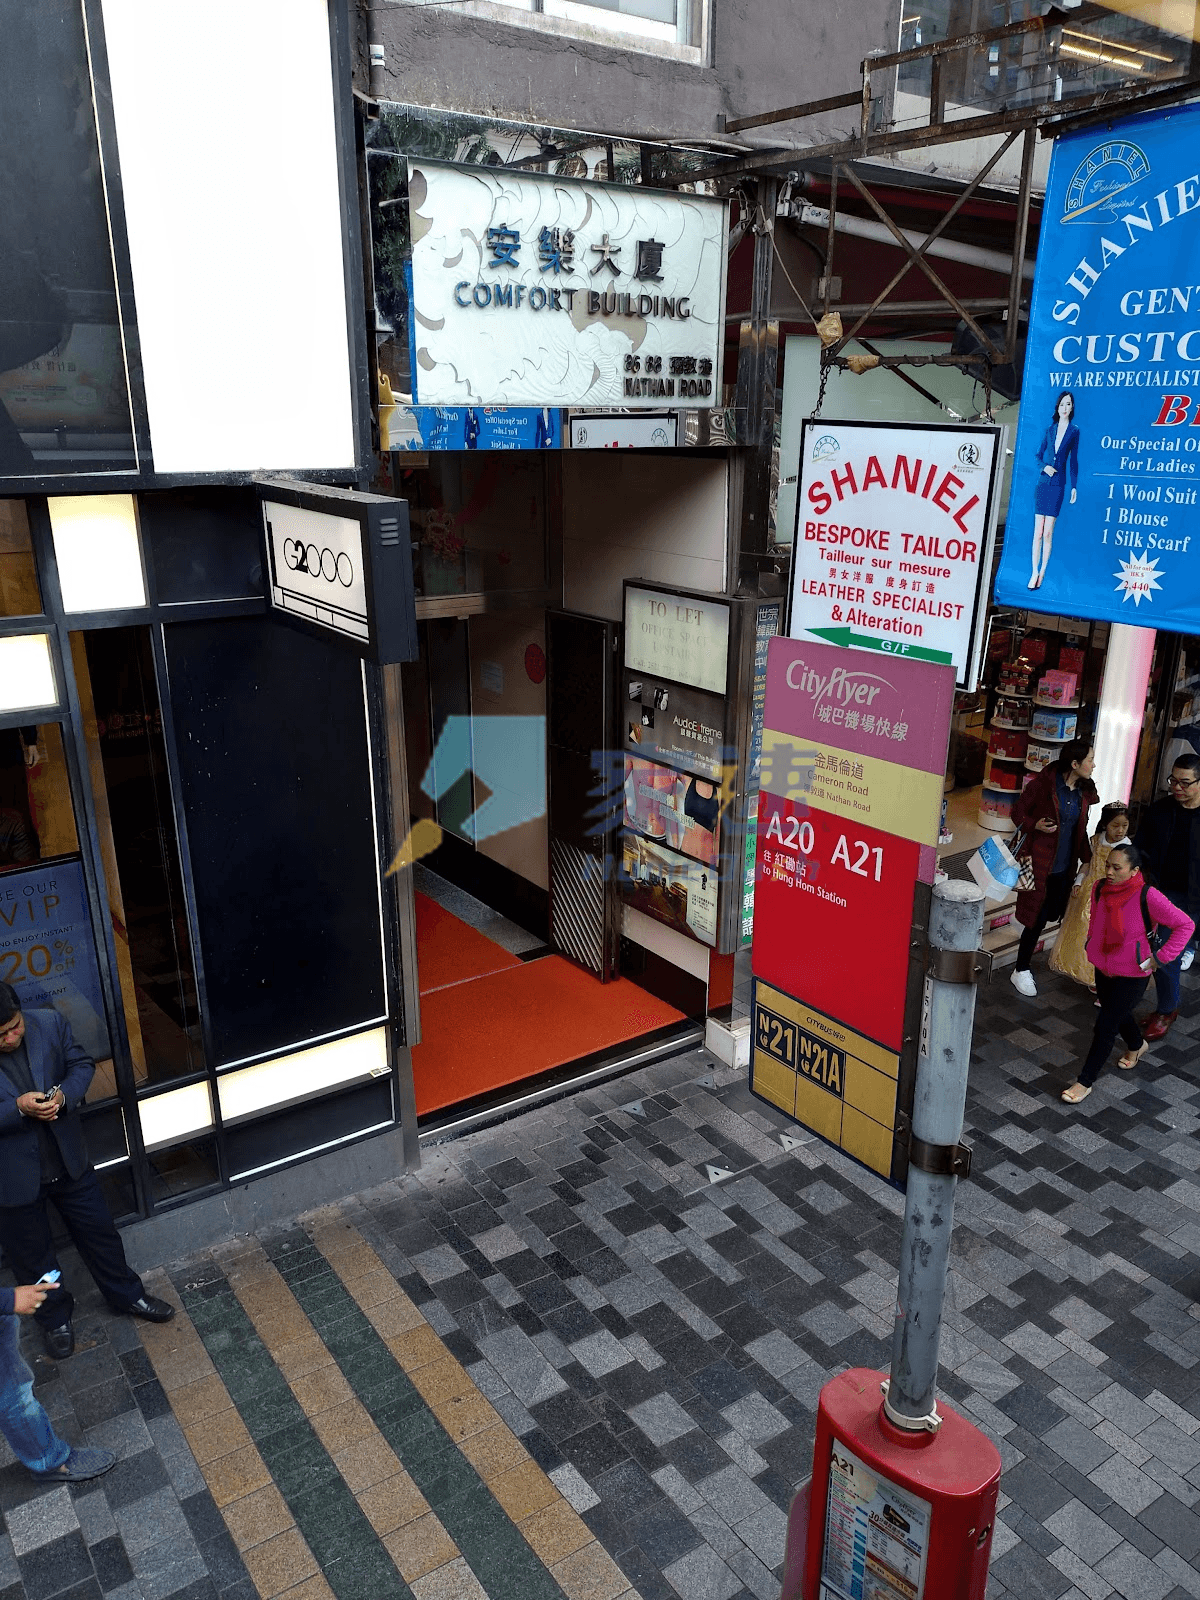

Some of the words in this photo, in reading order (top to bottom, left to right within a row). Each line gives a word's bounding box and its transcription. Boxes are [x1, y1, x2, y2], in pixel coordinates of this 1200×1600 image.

[1068, 144, 1147, 208] SHANIEL
[487, 222, 665, 282] 安樂大廈
[454, 281, 578, 311] COMFORT
[587, 291, 692, 319] BUILDING
[1120, 286, 1200, 316] GEN
[623, 354, 641, 374] 86
[645, 355, 662, 374] 88
[623, 376, 674, 397] NATHAN
[678, 377, 712, 398] ROAD
[1049, 372, 1072, 388] WE
[1075, 371, 1104, 388] ARE
[1106, 369, 1200, 388] SPECIALIST
[1101, 435, 1127, 450] Our
[1129, 437, 1180, 454] Special
[1120, 456, 1143, 471] For
[1146, 457, 1195, 475] Ladies
[807, 454, 980, 535] SHANIEL
[1107, 483, 1114, 500] 1
[1123, 484, 1161, 503] Wool
[1164, 486, 1198, 505] Suit
[1105, 507, 1111, 522] 1
[1118, 507, 1169, 527] Blouse
[804, 521, 890, 551] BESPOKE
[901, 533, 977, 562] TAILOR
[1101, 528, 1108, 544] 1
[1114, 530, 1144, 548] Silk
[1146, 532, 1191, 553] Scarf
[283, 537, 353, 587] G2000
[819, 547, 865, 567] Tailleur
[871, 558, 892, 570] sur
[899, 561, 951, 578] mesure
[828, 567, 874, 585] 男女洋服
[885, 576, 935, 594] 度身訂造
[1124, 580, 1149, 591] 2,440
[649, 600, 666, 617] TO
[675, 605, 704, 626] LET
[801, 579, 865, 604] LEATHER
[872, 591, 964, 620] SPECIALIST
[758, 608, 778, 622] 世宗
[831, 604, 843, 621] &
[846, 607, 923, 638] Alteration
[881, 639, 910, 654] G/F
[785, 659, 884, 714] Cityflyer
[817, 703, 909, 742] 城巴機場快線
[814, 752, 864, 780] 金馬倫道
[807, 770, 844, 791] Cameron
[847, 782, 869, 797] Road
[826, 787, 851, 806] Nathan
[853, 799, 871, 812] Road
[765, 811, 815, 855] A20
[830, 834, 883, 882] A21
[764, 850, 772, 863] 往
[774, 852, 806, 877] 紅磡站
[23, 881, 57, 897] OUR
[763, 864, 771, 875] to
[772, 867, 794, 888] Hung
[795, 878, 815, 895] Hom
[816, 885, 847, 908] Station
[0, 895, 60, 927] VIP
[13, 933, 39, 946] ENJOY
[41, 925, 73, 938] INSTANT
[35, 987, 67, 1001] INSTANT
[806, 1016, 833, 1036] CITYBUS
[759, 1012, 793, 1063] N21
[800, 1035, 841, 1093] N21A
[831, 1453, 854, 1477] A21
